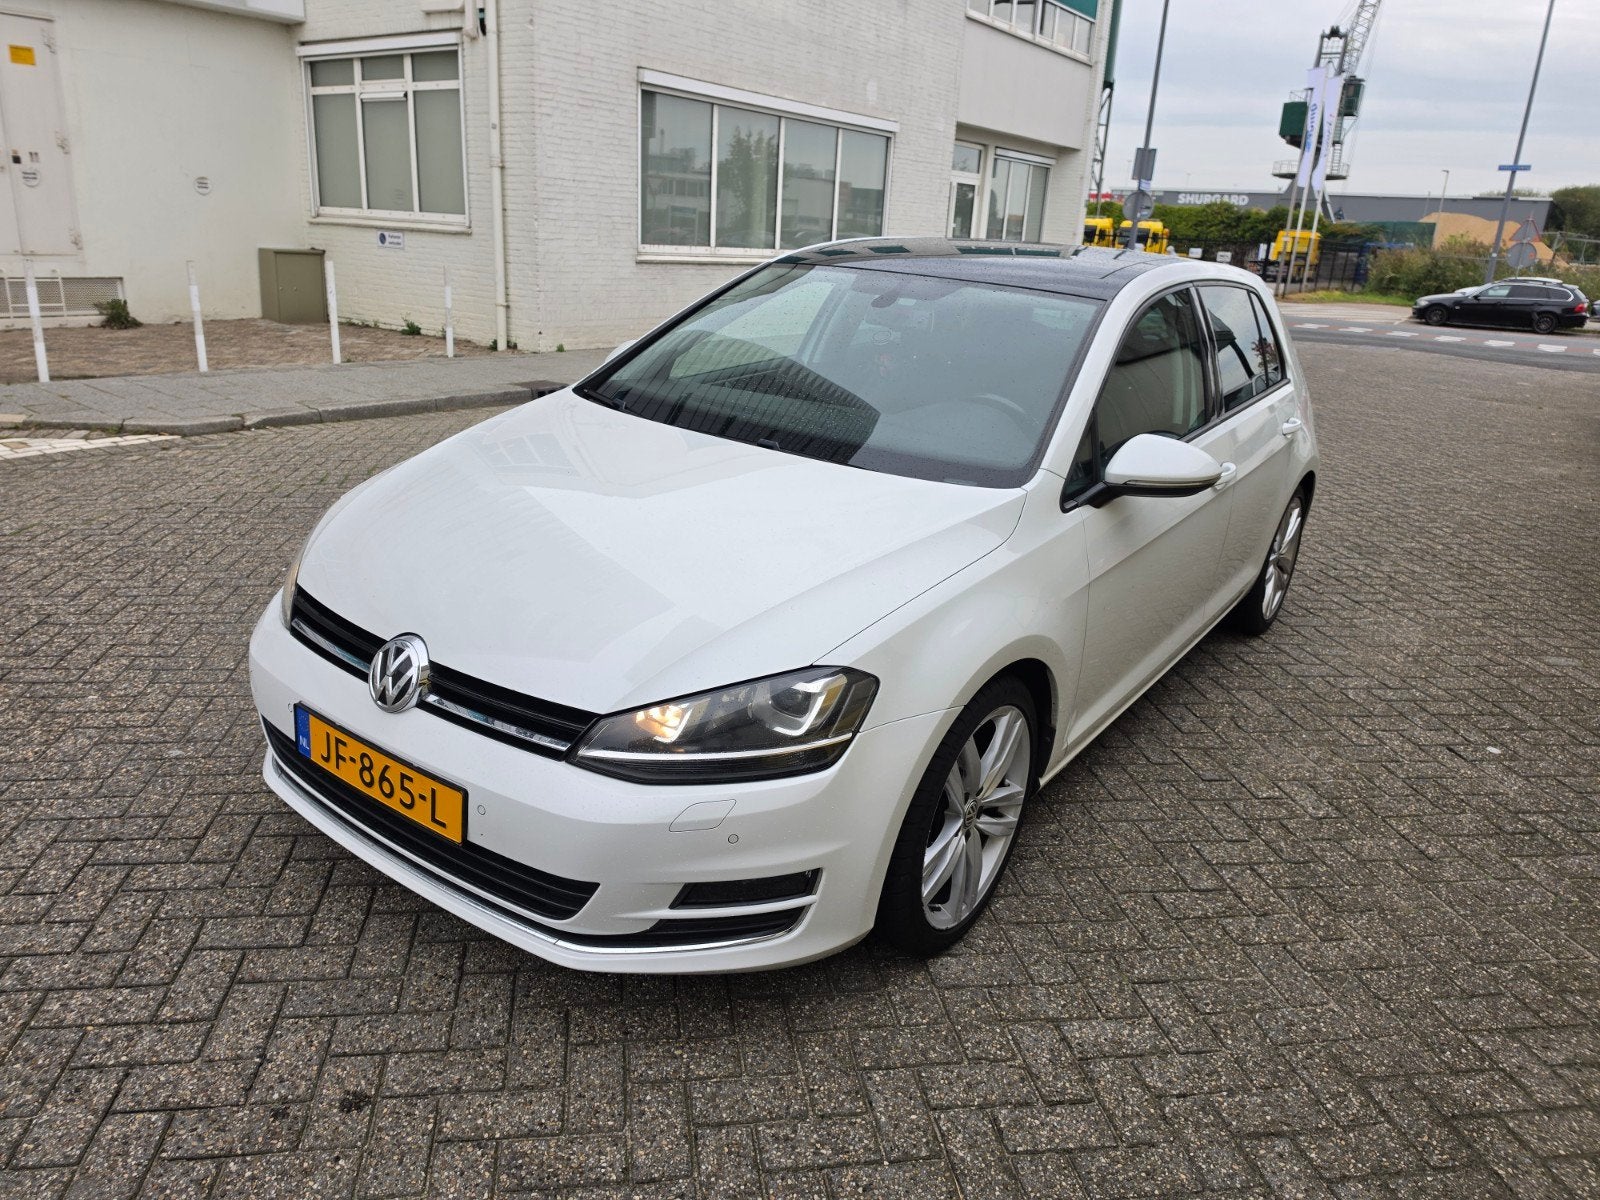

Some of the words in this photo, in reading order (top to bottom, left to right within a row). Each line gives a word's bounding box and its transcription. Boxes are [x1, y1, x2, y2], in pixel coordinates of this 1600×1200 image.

[1177, 193, 1250, 206] SHURGARD
[299, 735, 310, 750] NL
[320, 731, 447, 829] JF-865-L
